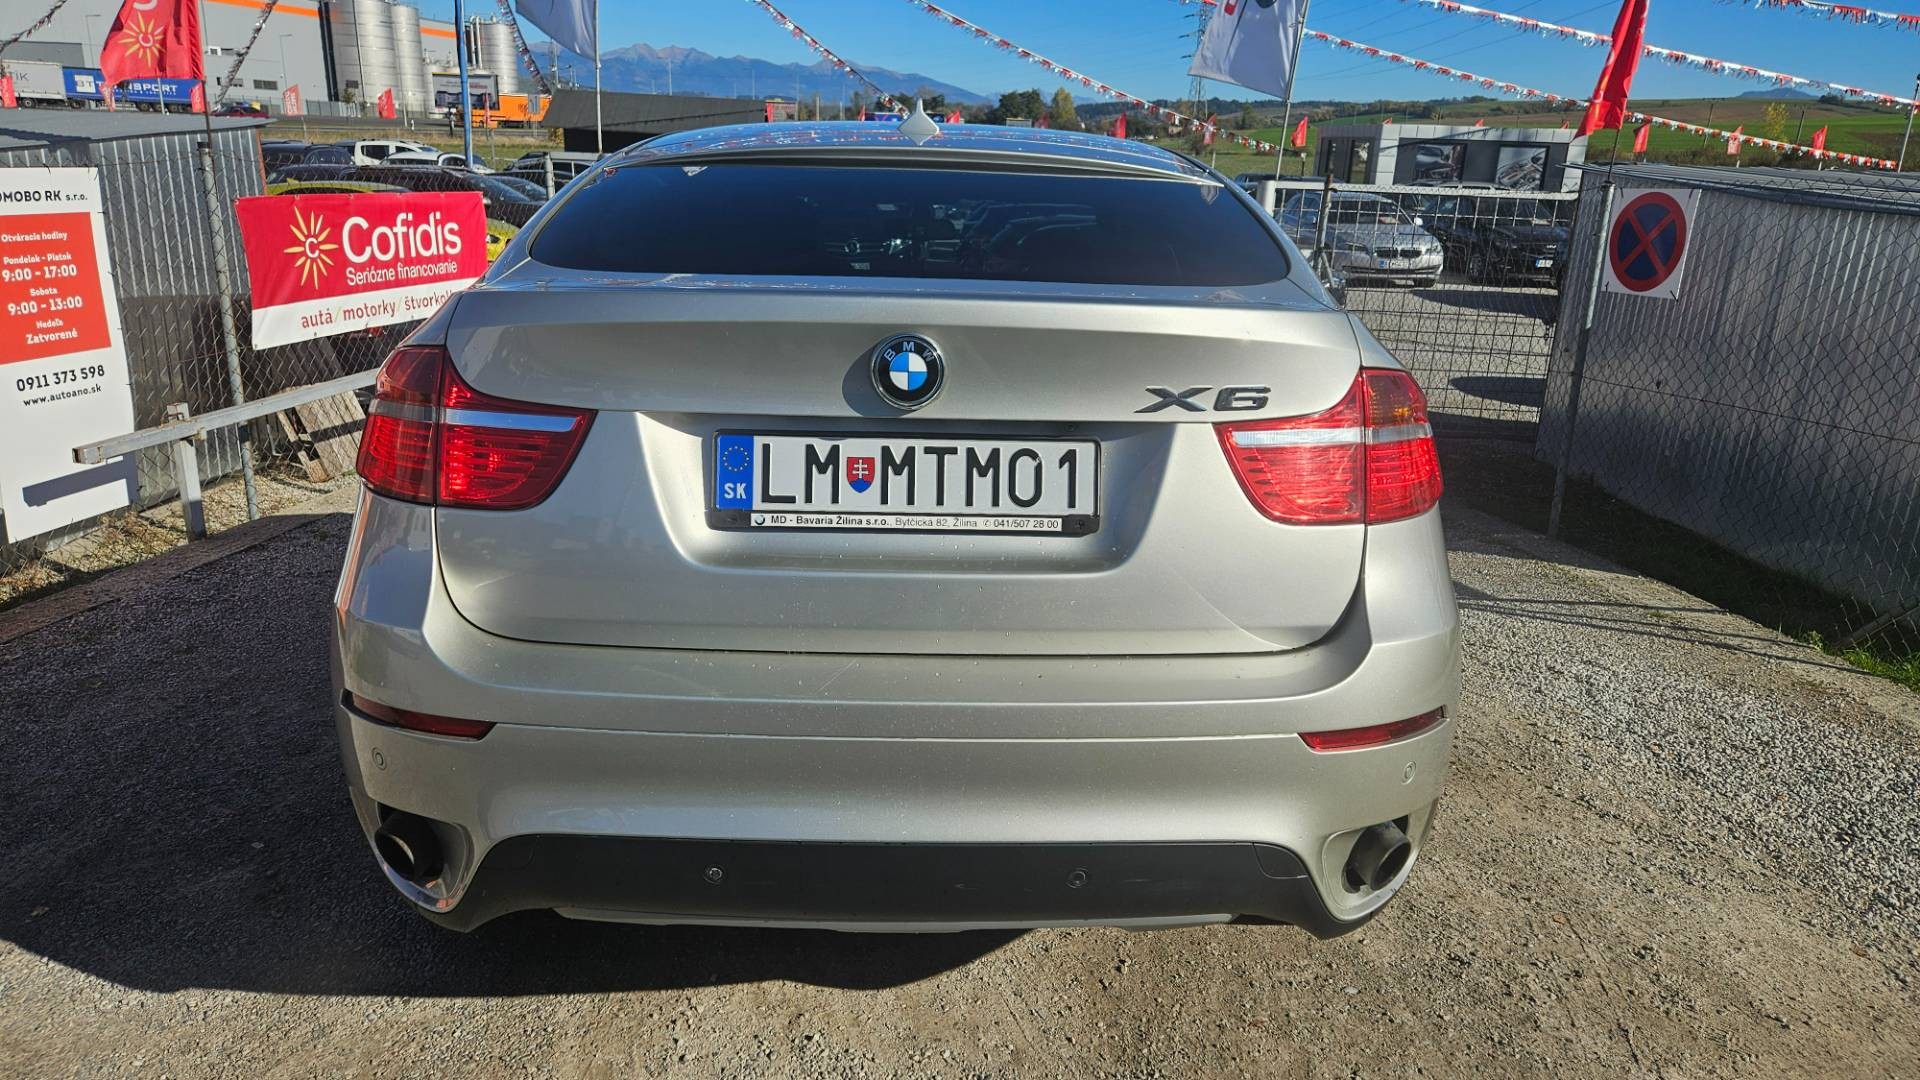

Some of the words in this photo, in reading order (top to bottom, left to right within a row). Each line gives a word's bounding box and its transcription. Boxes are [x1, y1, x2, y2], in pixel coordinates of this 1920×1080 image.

[96, 81, 178, 92] TNSPORT
[0, 190, 42, 202] MOBO
[45, 190, 62, 201] RK
[42, 231, 68, 241] hodiny
[342, 211, 462, 263] Cofidis
[3, 255, 41, 265] Pondelok
[2, 268, 32, 282] 9:00
[43, 264, 77, 279] 17:00
[346, 268, 395, 286] Seriózne
[398, 261, 458, 280] financovanie
[30, 287, 58, 296] Sobota
[8, 301, 38, 316] 9:00
[49, 296, 83, 311] 13:00
[343, 301, 396, 321] motorky
[404, 290, 452, 311] štvorkol
[26, 327, 78, 344] Zatvorené
[884, 341, 935, 361] BMW
[16, 374, 50, 391] 0911
[53, 369, 77, 385] 373
[80, 364, 105, 380] 598
[23, 383, 102, 407] www.autoano.sk
[1134, 385, 1272, 413] X6
[761, 443, 840, 504] LM
[724, 483, 746, 499] SK
[771, 515, 787, 524] MD
[796, 515, 833, 525] Bavaria
[836, 515, 863, 525] Žilina
[953, 517, 978, 528] Žilina
[993, 519, 1031, 528] 041/507
[1033, 519, 1045, 528] 28
[1047, 520, 1059, 528] 00
